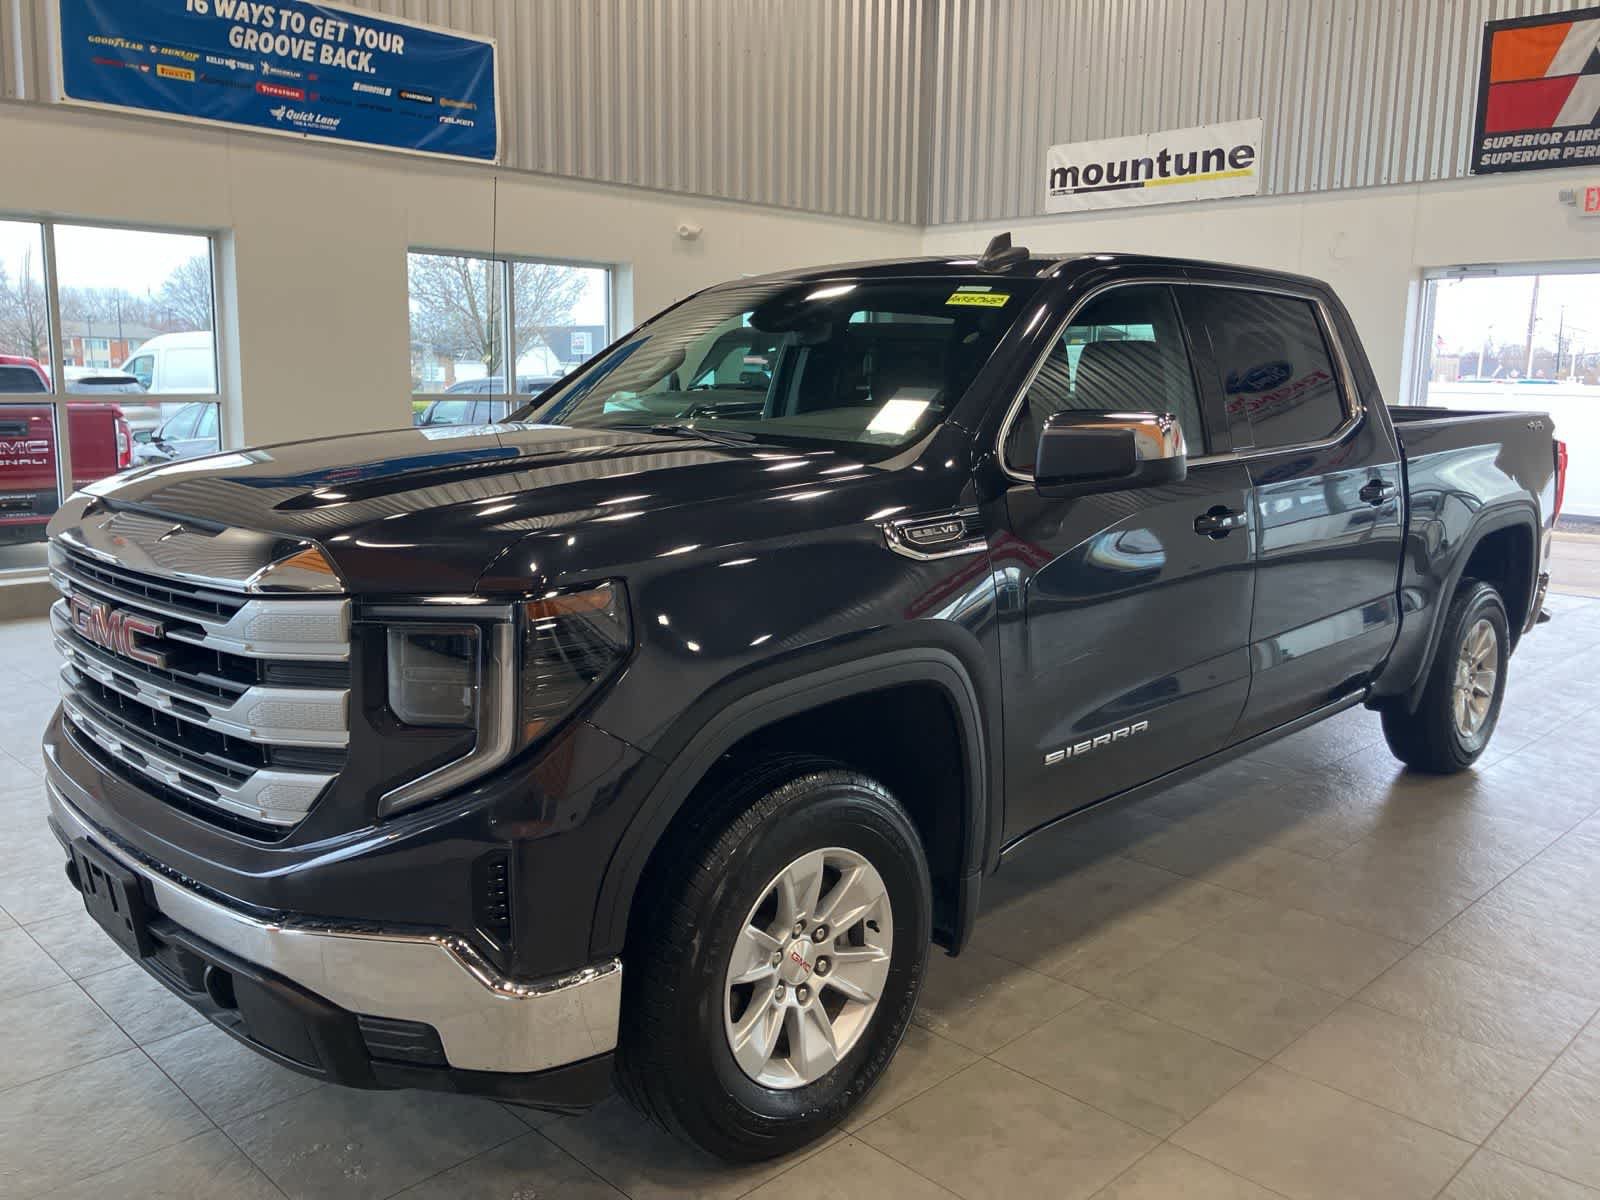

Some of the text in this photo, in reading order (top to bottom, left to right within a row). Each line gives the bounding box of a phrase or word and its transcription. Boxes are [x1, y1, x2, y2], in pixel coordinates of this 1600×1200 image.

[214, 0, 275, 28] WAYS
[279, 9, 305, 34] TO
[309, 16, 349, 42] GET
[353, 25, 404, 55] YOUR
[160, 47, 199, 62] DUNLOP
[229, 26, 376, 74] GROOVE BACK.
[285, 109, 341, 126] Quick Lane
[1480, 148, 1561, 165] SUPERIOR
[1482, 132, 1563, 150] SUPERIOR
[1050, 144, 1255, 189] mountune
[71, 593, 167, 669] GMC
[1044, 720, 1149, 766] SIERRA
[791, 951, 812, 974] GMC
